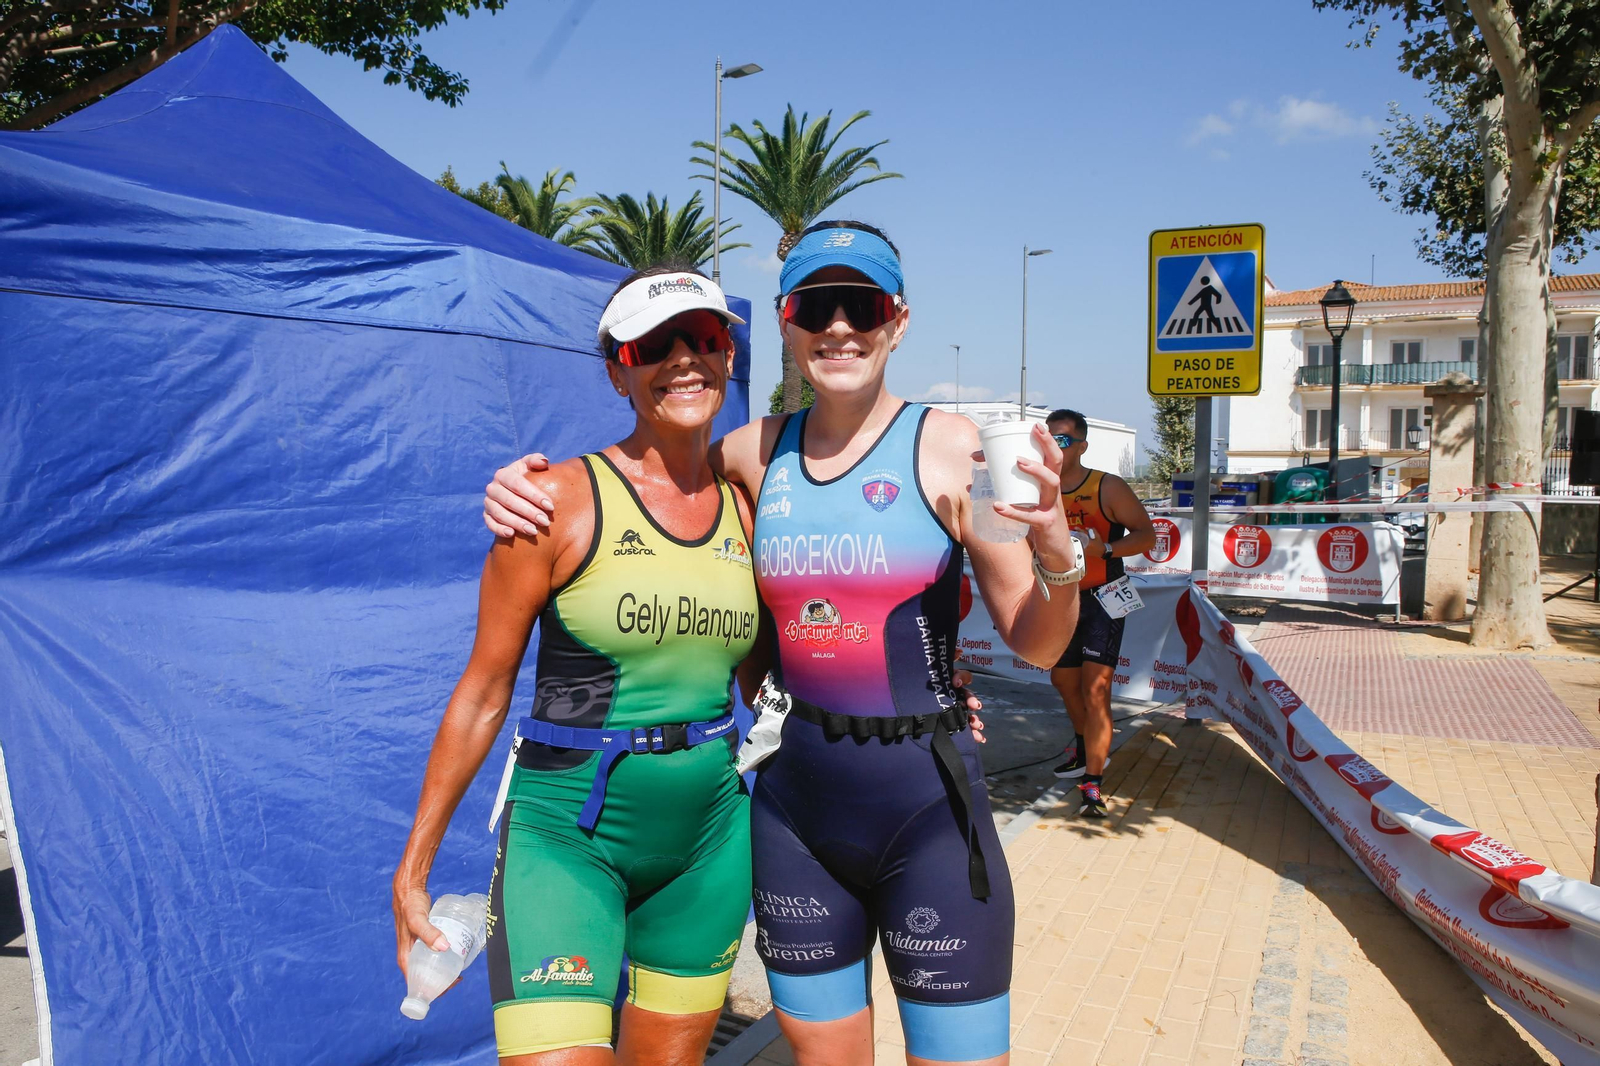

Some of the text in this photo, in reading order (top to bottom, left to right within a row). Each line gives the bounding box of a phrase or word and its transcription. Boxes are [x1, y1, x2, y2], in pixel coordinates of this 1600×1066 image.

[1170, 230, 1243, 249] ATENCIÓN
[1174, 358, 1235, 371] PASO DE
[1167, 376, 1241, 390] PEATONES
[613, 547, 657, 557] austral
[760, 533, 890, 577] BOBCEKOVA
[1208, 569, 1232, 579] Delegación
[1233, 571, 1255, 580] Municipal
[1264, 572, 1285, 582] Deportes
[1301, 575, 1327, 584] Delegación
[1328, 576, 1352, 585] Municipal
[1361, 578, 1383, 586] Deportes
[1222, 580, 1252, 589] Ayuntamiento
[1270, 584, 1285, 592] Roque
[1315, 586, 1349, 595] Ayuntamiento
[1357, 588, 1367, 596] San
[1368, 589, 1383, 597] Roque
[1114, 586, 1133, 603] 15
[616, 592, 755, 647] Gely Blanquer
[962, 637, 992, 650] Deportes
[915, 615, 951, 713] BAHIA MALA
[971, 654, 993, 666] Roque
[938, 634, 957, 704] TRIATLO
[1154, 660, 1187, 675] Delegación
[1113, 674, 1130, 684] oque
[754, 888, 821, 907] CLÍNICA
[885, 931, 967, 952] Vidamía
[922, 981, 970, 990] HOBBY
